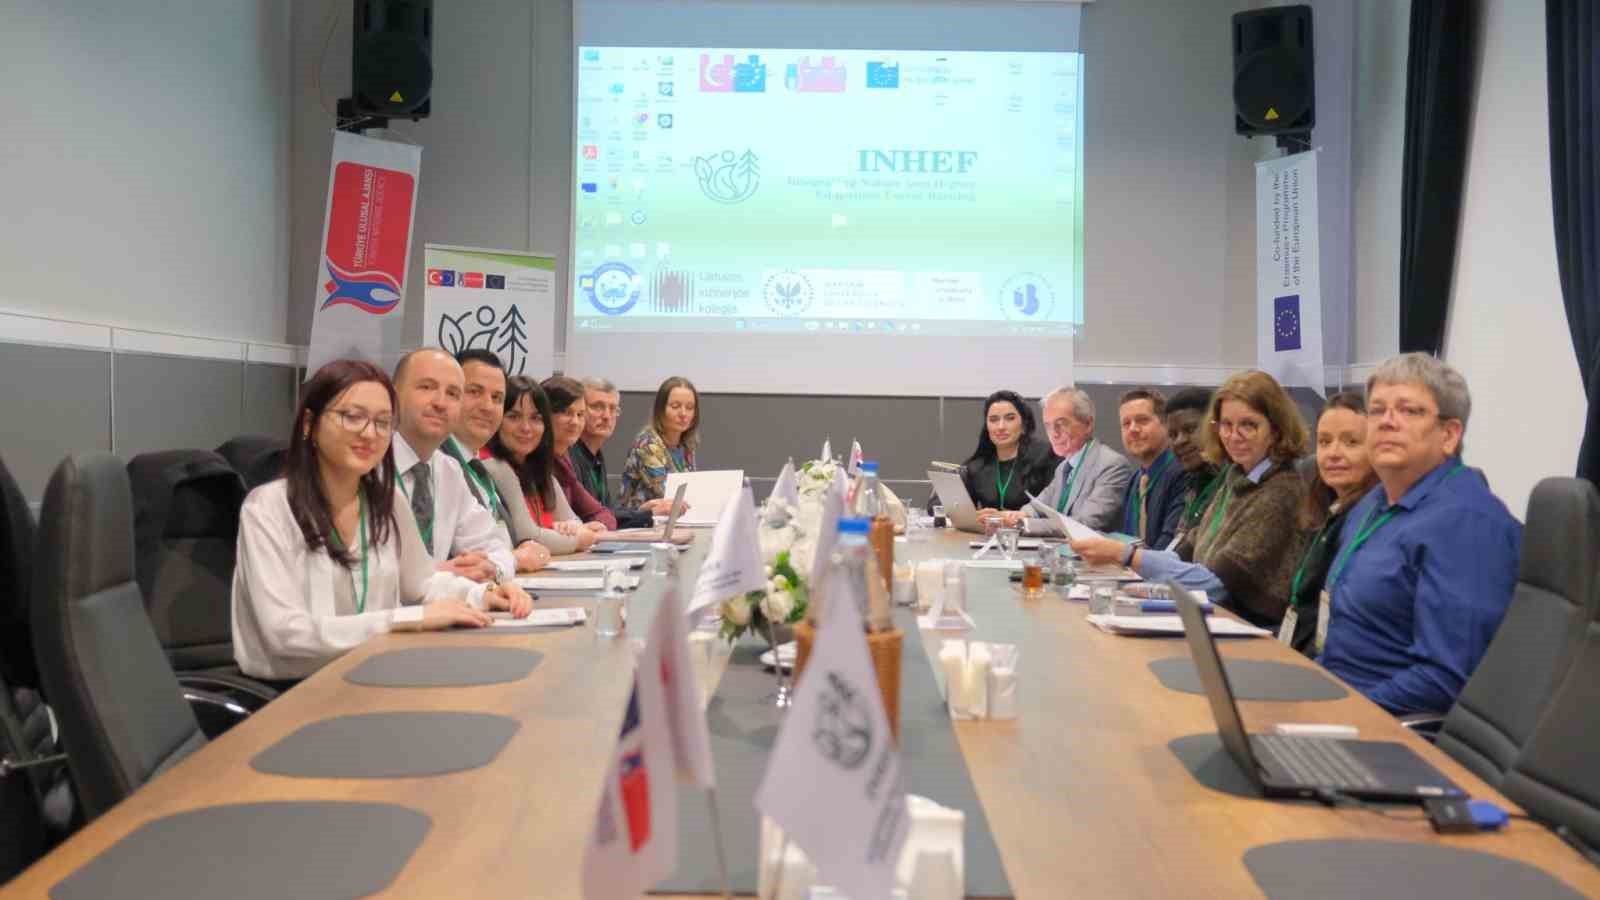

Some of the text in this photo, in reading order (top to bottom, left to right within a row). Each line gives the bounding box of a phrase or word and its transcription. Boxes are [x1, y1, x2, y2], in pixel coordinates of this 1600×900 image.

[856, 149, 978, 173] INHEF
[361, 168, 373, 200] AJANSI
[1291, 168, 1300, 201] Union
[357, 202, 369, 232] ULUSAL
[1291, 202, 1301, 254] European
[1272, 207, 1281, 263] Co-funded
